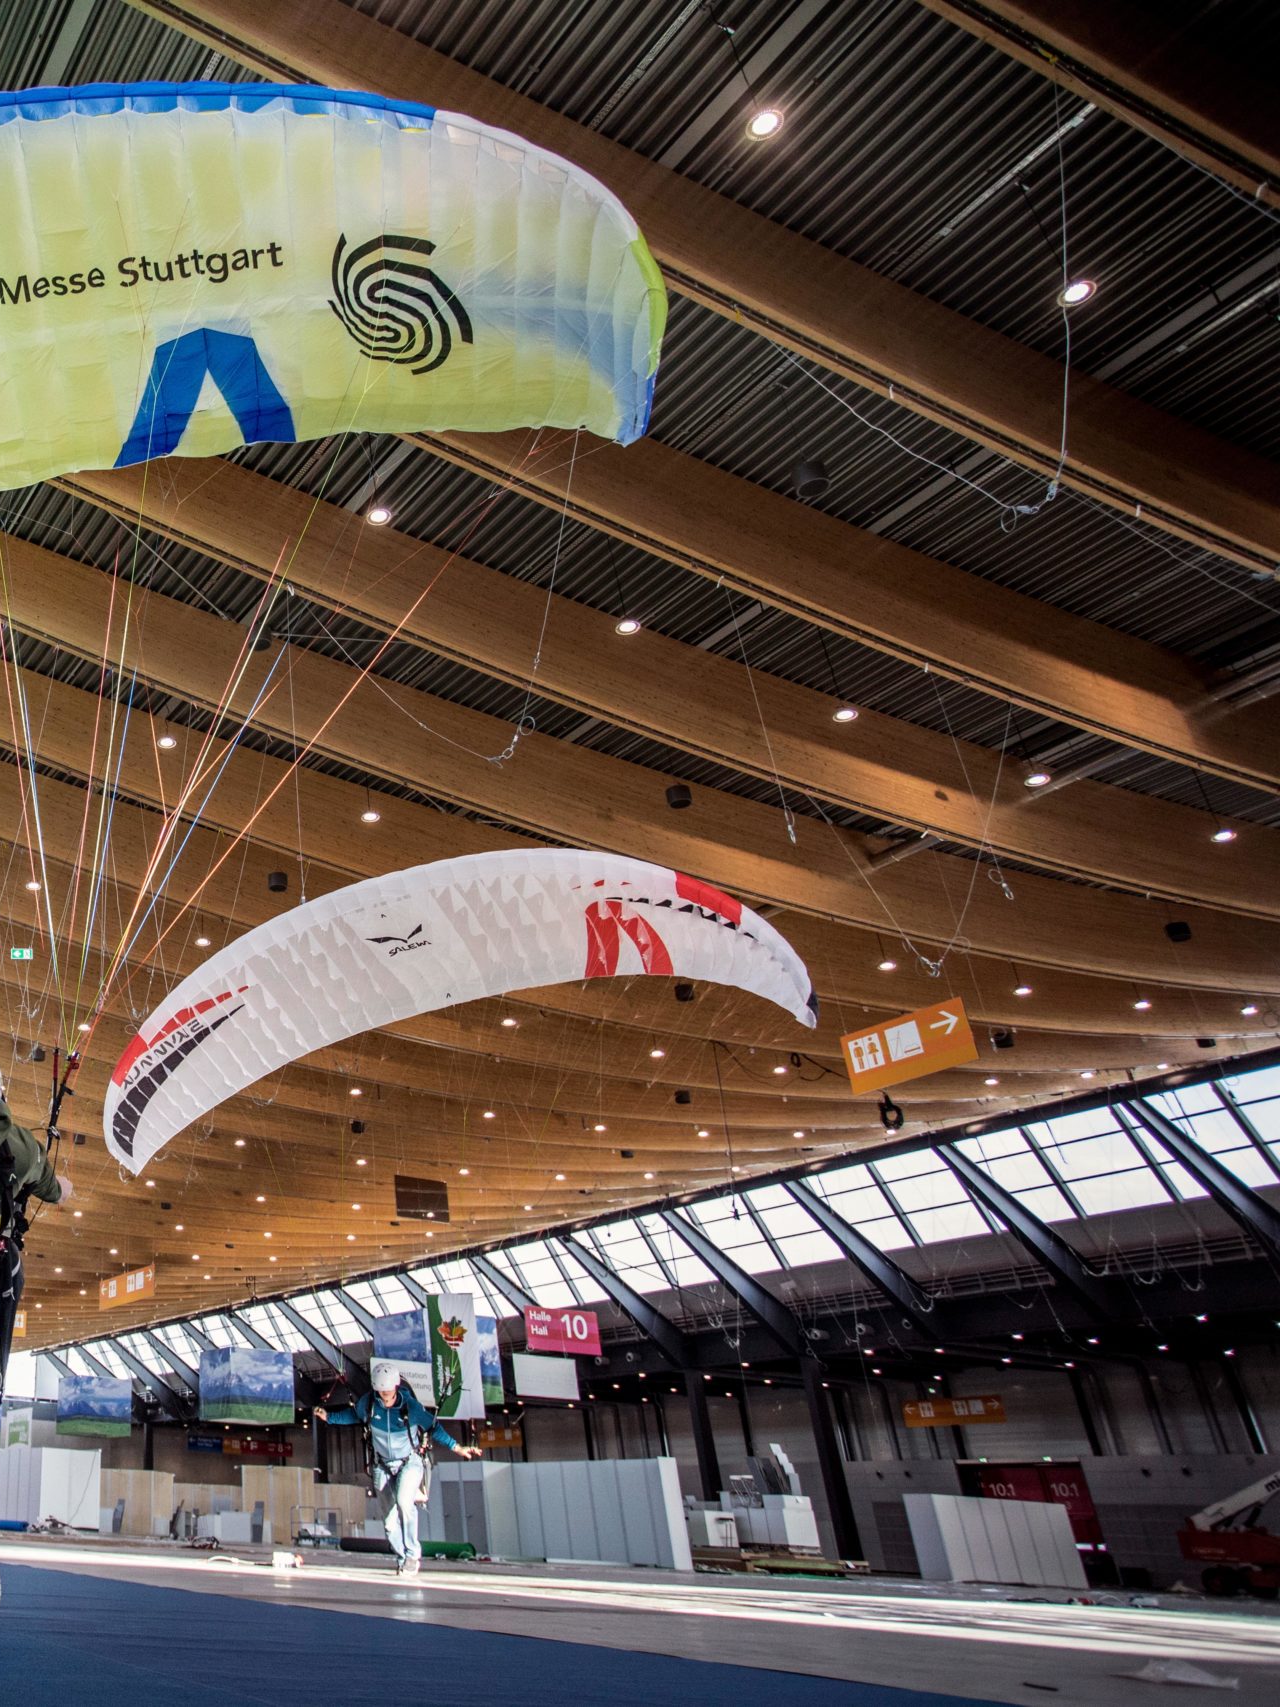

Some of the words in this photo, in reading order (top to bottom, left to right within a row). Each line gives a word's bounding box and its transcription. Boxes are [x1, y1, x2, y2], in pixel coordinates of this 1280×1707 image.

[117, 242, 283, 288] Stuttgart
[529, 1310, 552, 1322] Halle
[561, 1314, 588, 1340] 10
[531, 1324, 548, 1336] Hall
[989, 1483, 1016, 1497] 10.1
[1050, 1482, 1079, 1497] 10.1
